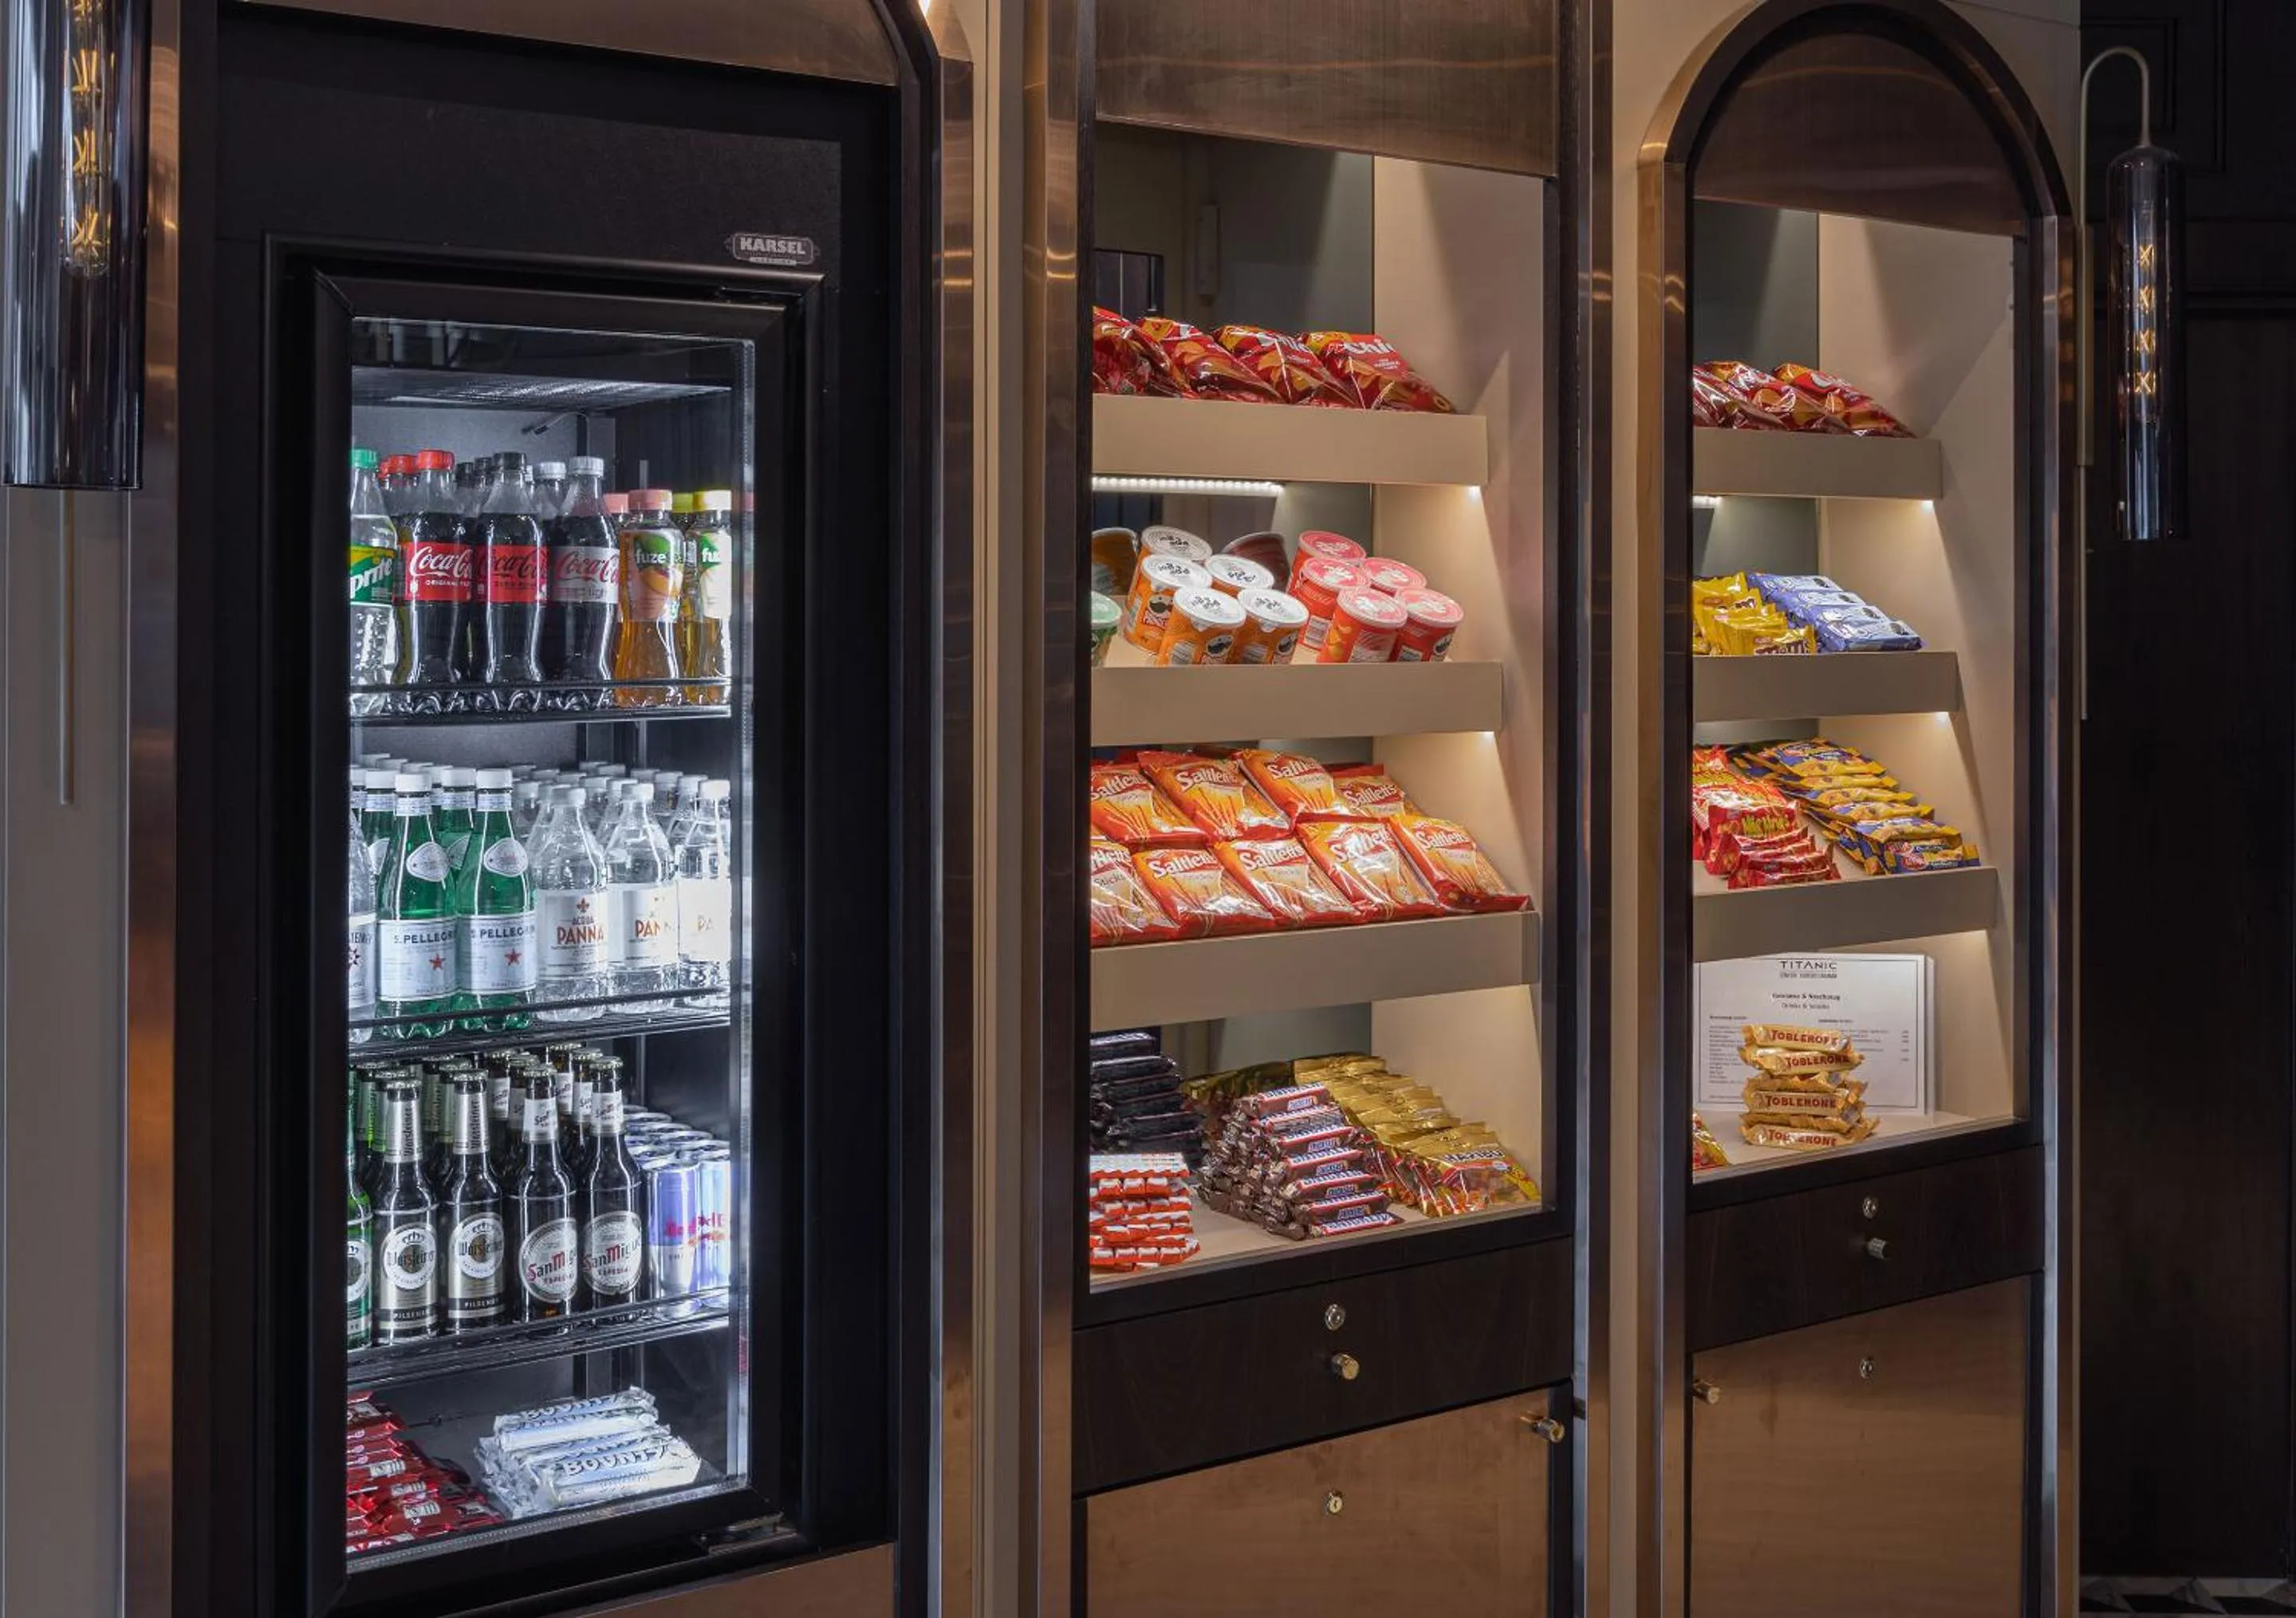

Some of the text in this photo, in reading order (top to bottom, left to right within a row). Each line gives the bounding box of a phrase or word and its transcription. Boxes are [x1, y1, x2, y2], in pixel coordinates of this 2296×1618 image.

[740, 236, 805, 254] KARSEL
[1343, 337, 1396, 355] Chi
[635, 549, 667, 563] fuze
[349, 558, 392, 599] prite
[556, 925, 605, 945] PANNA
[1780, 961, 1837, 970] TITANIC
[1765, 1096, 1837, 1108] TOBLERONE
[1767, 1129, 1838, 1147] TOBERONE
[565, 1443, 667, 1477] BOUNTY
